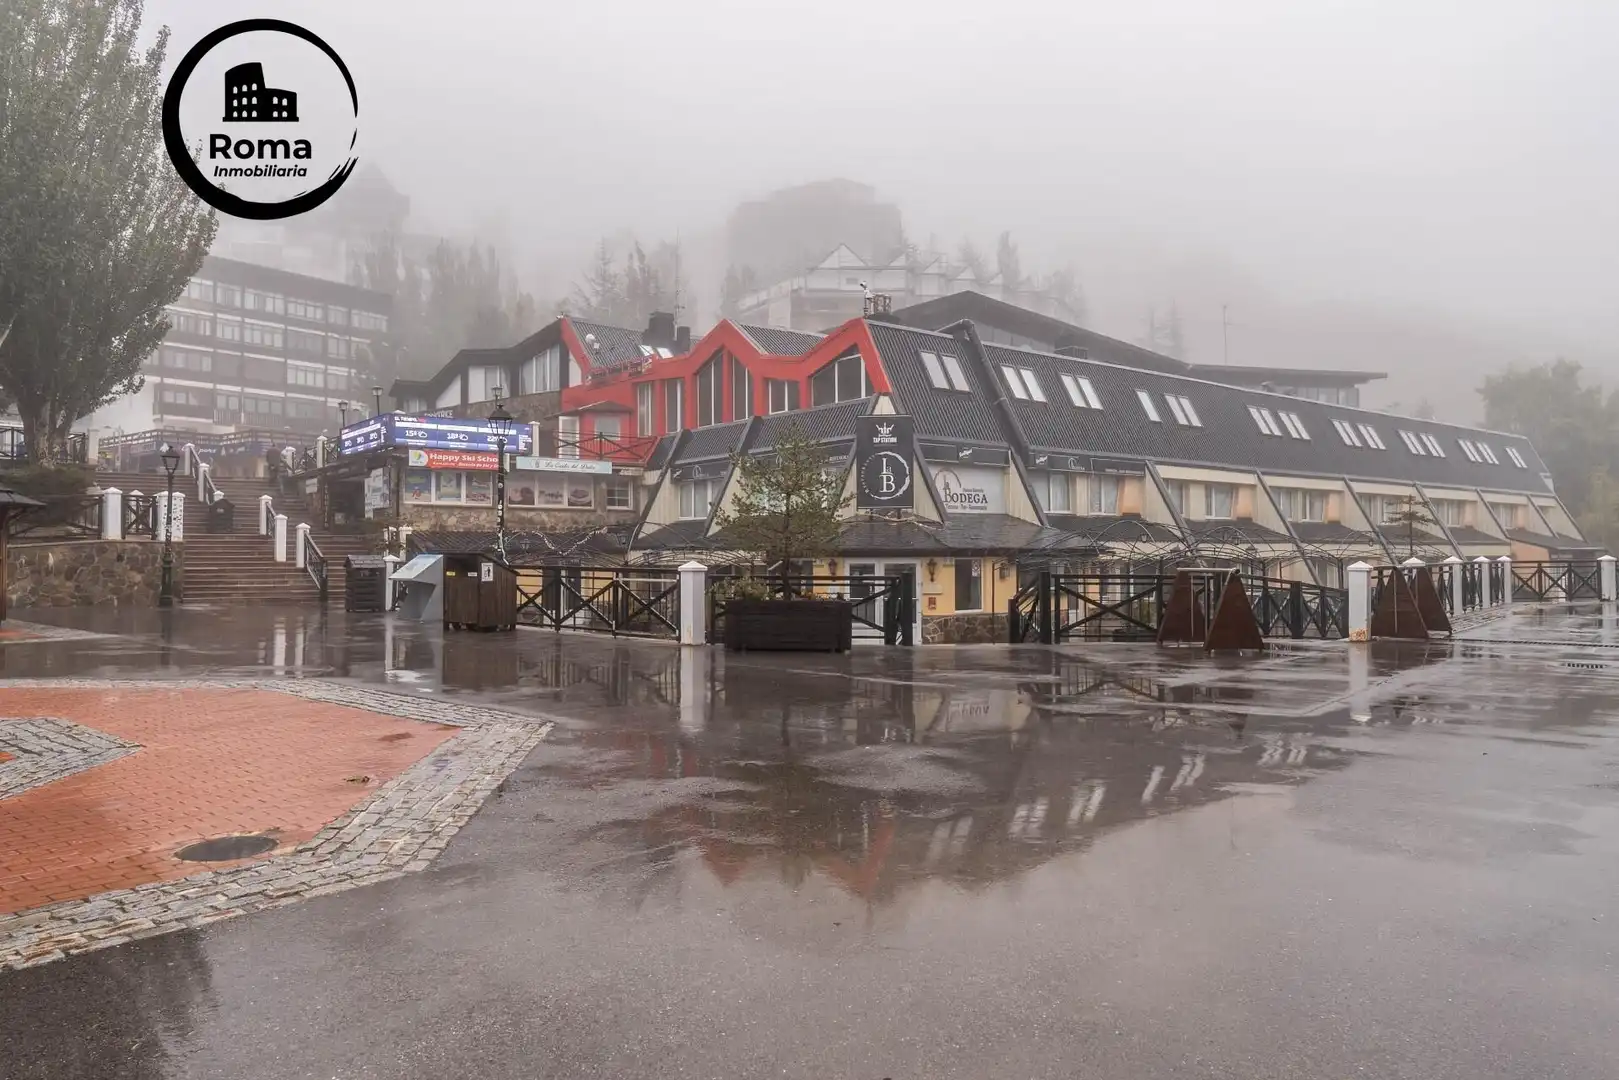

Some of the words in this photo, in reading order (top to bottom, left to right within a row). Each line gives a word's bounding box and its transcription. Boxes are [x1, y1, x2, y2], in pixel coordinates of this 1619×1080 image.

[429, 453, 460, 463] Happy
[461, 454, 476, 462] Ski
[477, 455, 501, 463] Scho
[879, 474, 896, 493] B
